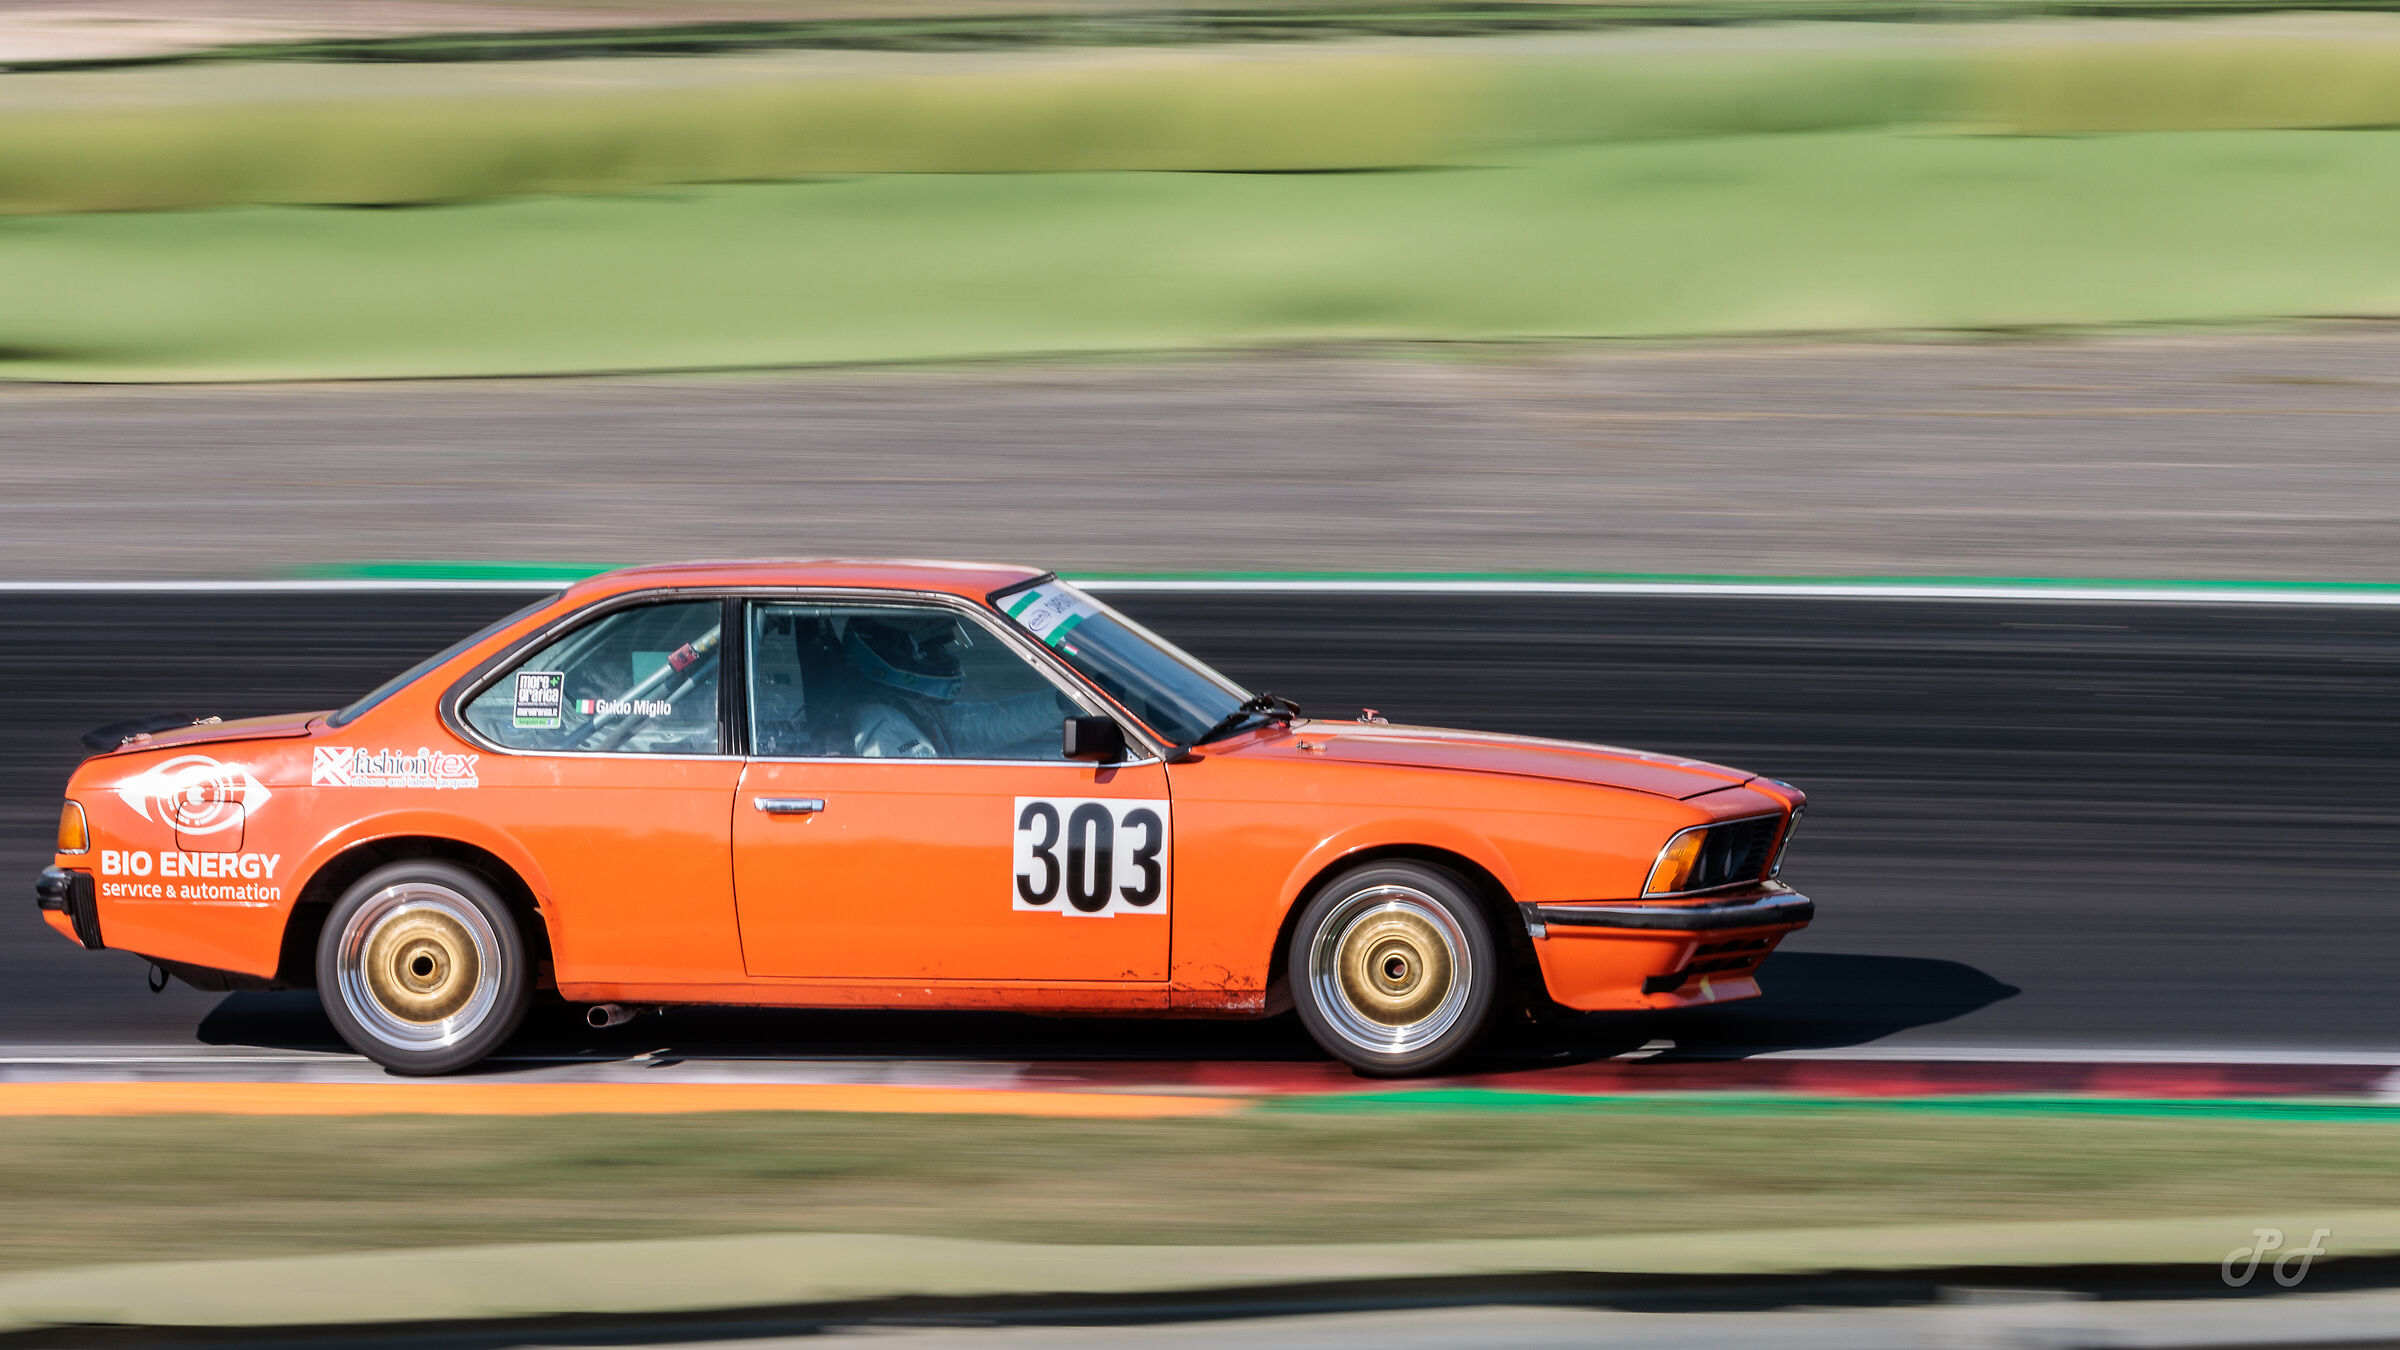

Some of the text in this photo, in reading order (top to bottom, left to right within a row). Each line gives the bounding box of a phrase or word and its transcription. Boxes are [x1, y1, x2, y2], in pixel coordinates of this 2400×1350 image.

[596, 699, 672, 718] Guido Miglio
[352, 777, 478, 790] ribbons and labels jacquard
[101, 850, 281, 879] BIO ENERGY
[1016, 802, 1163, 912] 303
[102, 882, 281, 900] service & automation
